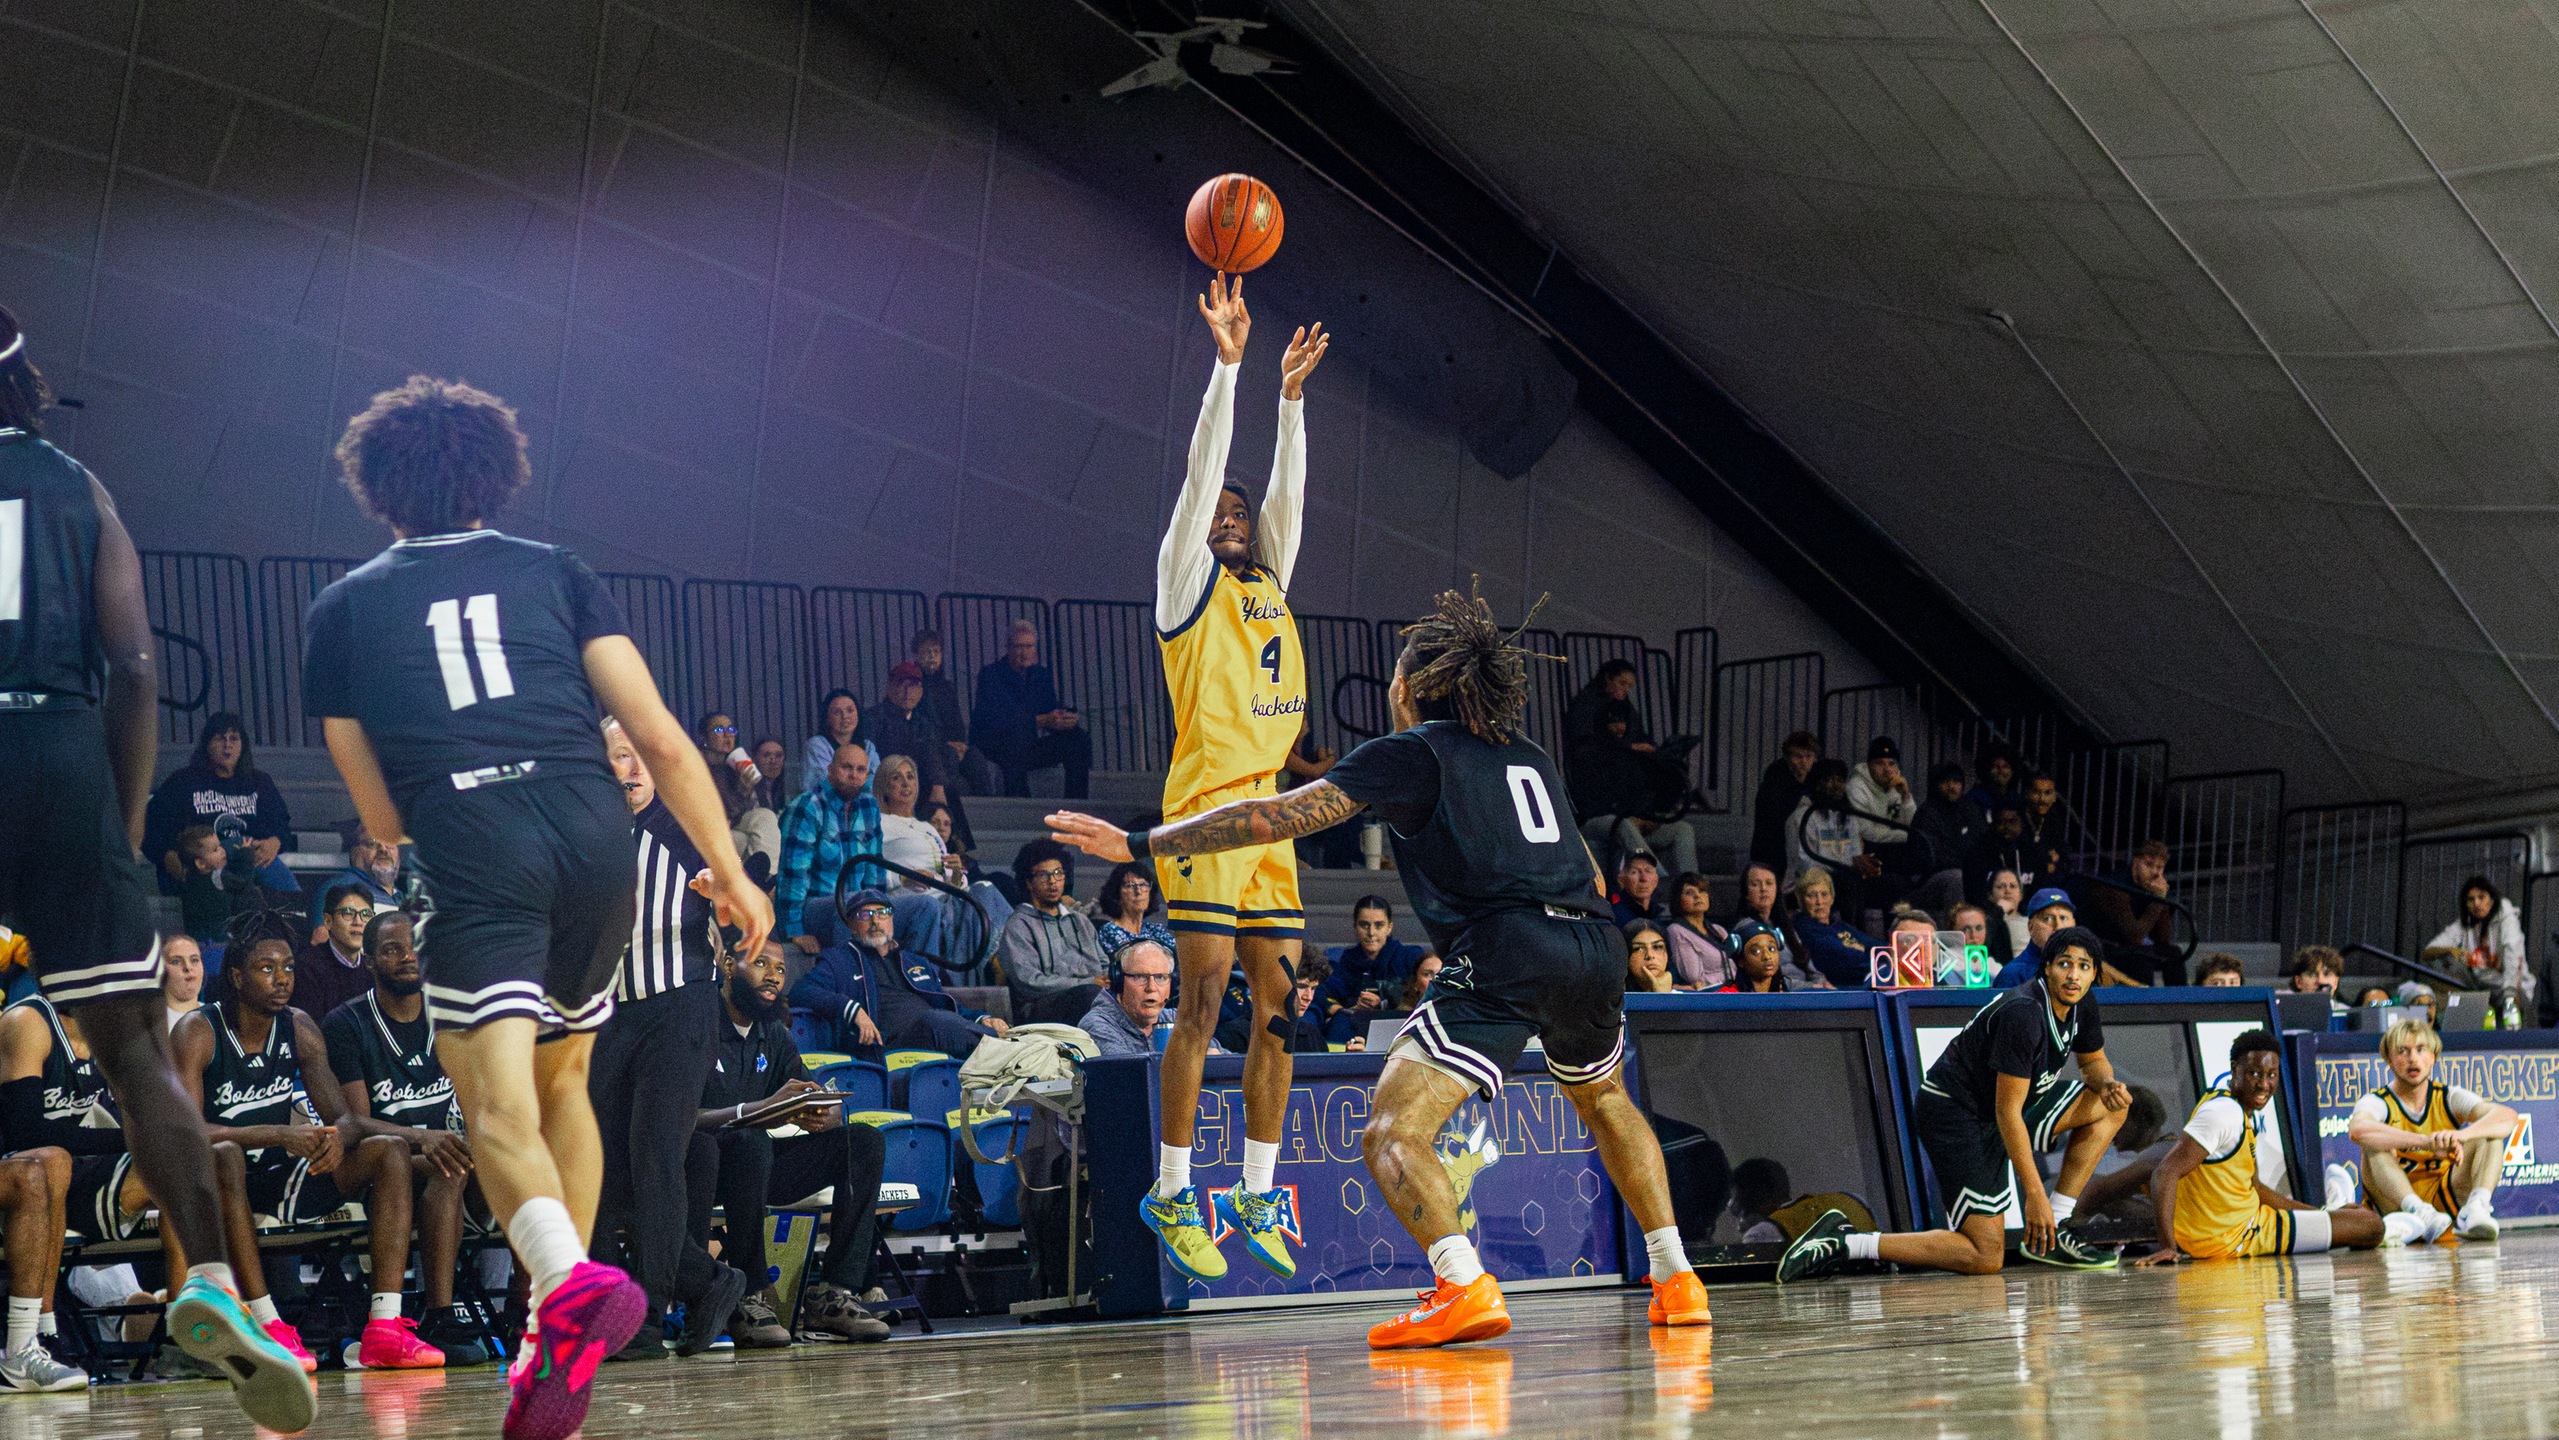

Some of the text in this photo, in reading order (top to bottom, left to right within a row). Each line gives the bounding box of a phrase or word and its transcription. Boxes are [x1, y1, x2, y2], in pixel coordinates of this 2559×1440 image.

[426, 593, 515, 711] 11
[1260, 633, 1281, 684] 4
[1251, 693, 1306, 718] Jackets
[1506, 765, 1560, 843] 0
[214, 1075, 294, 1106] Bobcats
[371, 1076, 454, 1103] Bobcats
[2319, 1115, 2353, 1138] gujac
[878, 1189, 909, 1200] ACKETS
